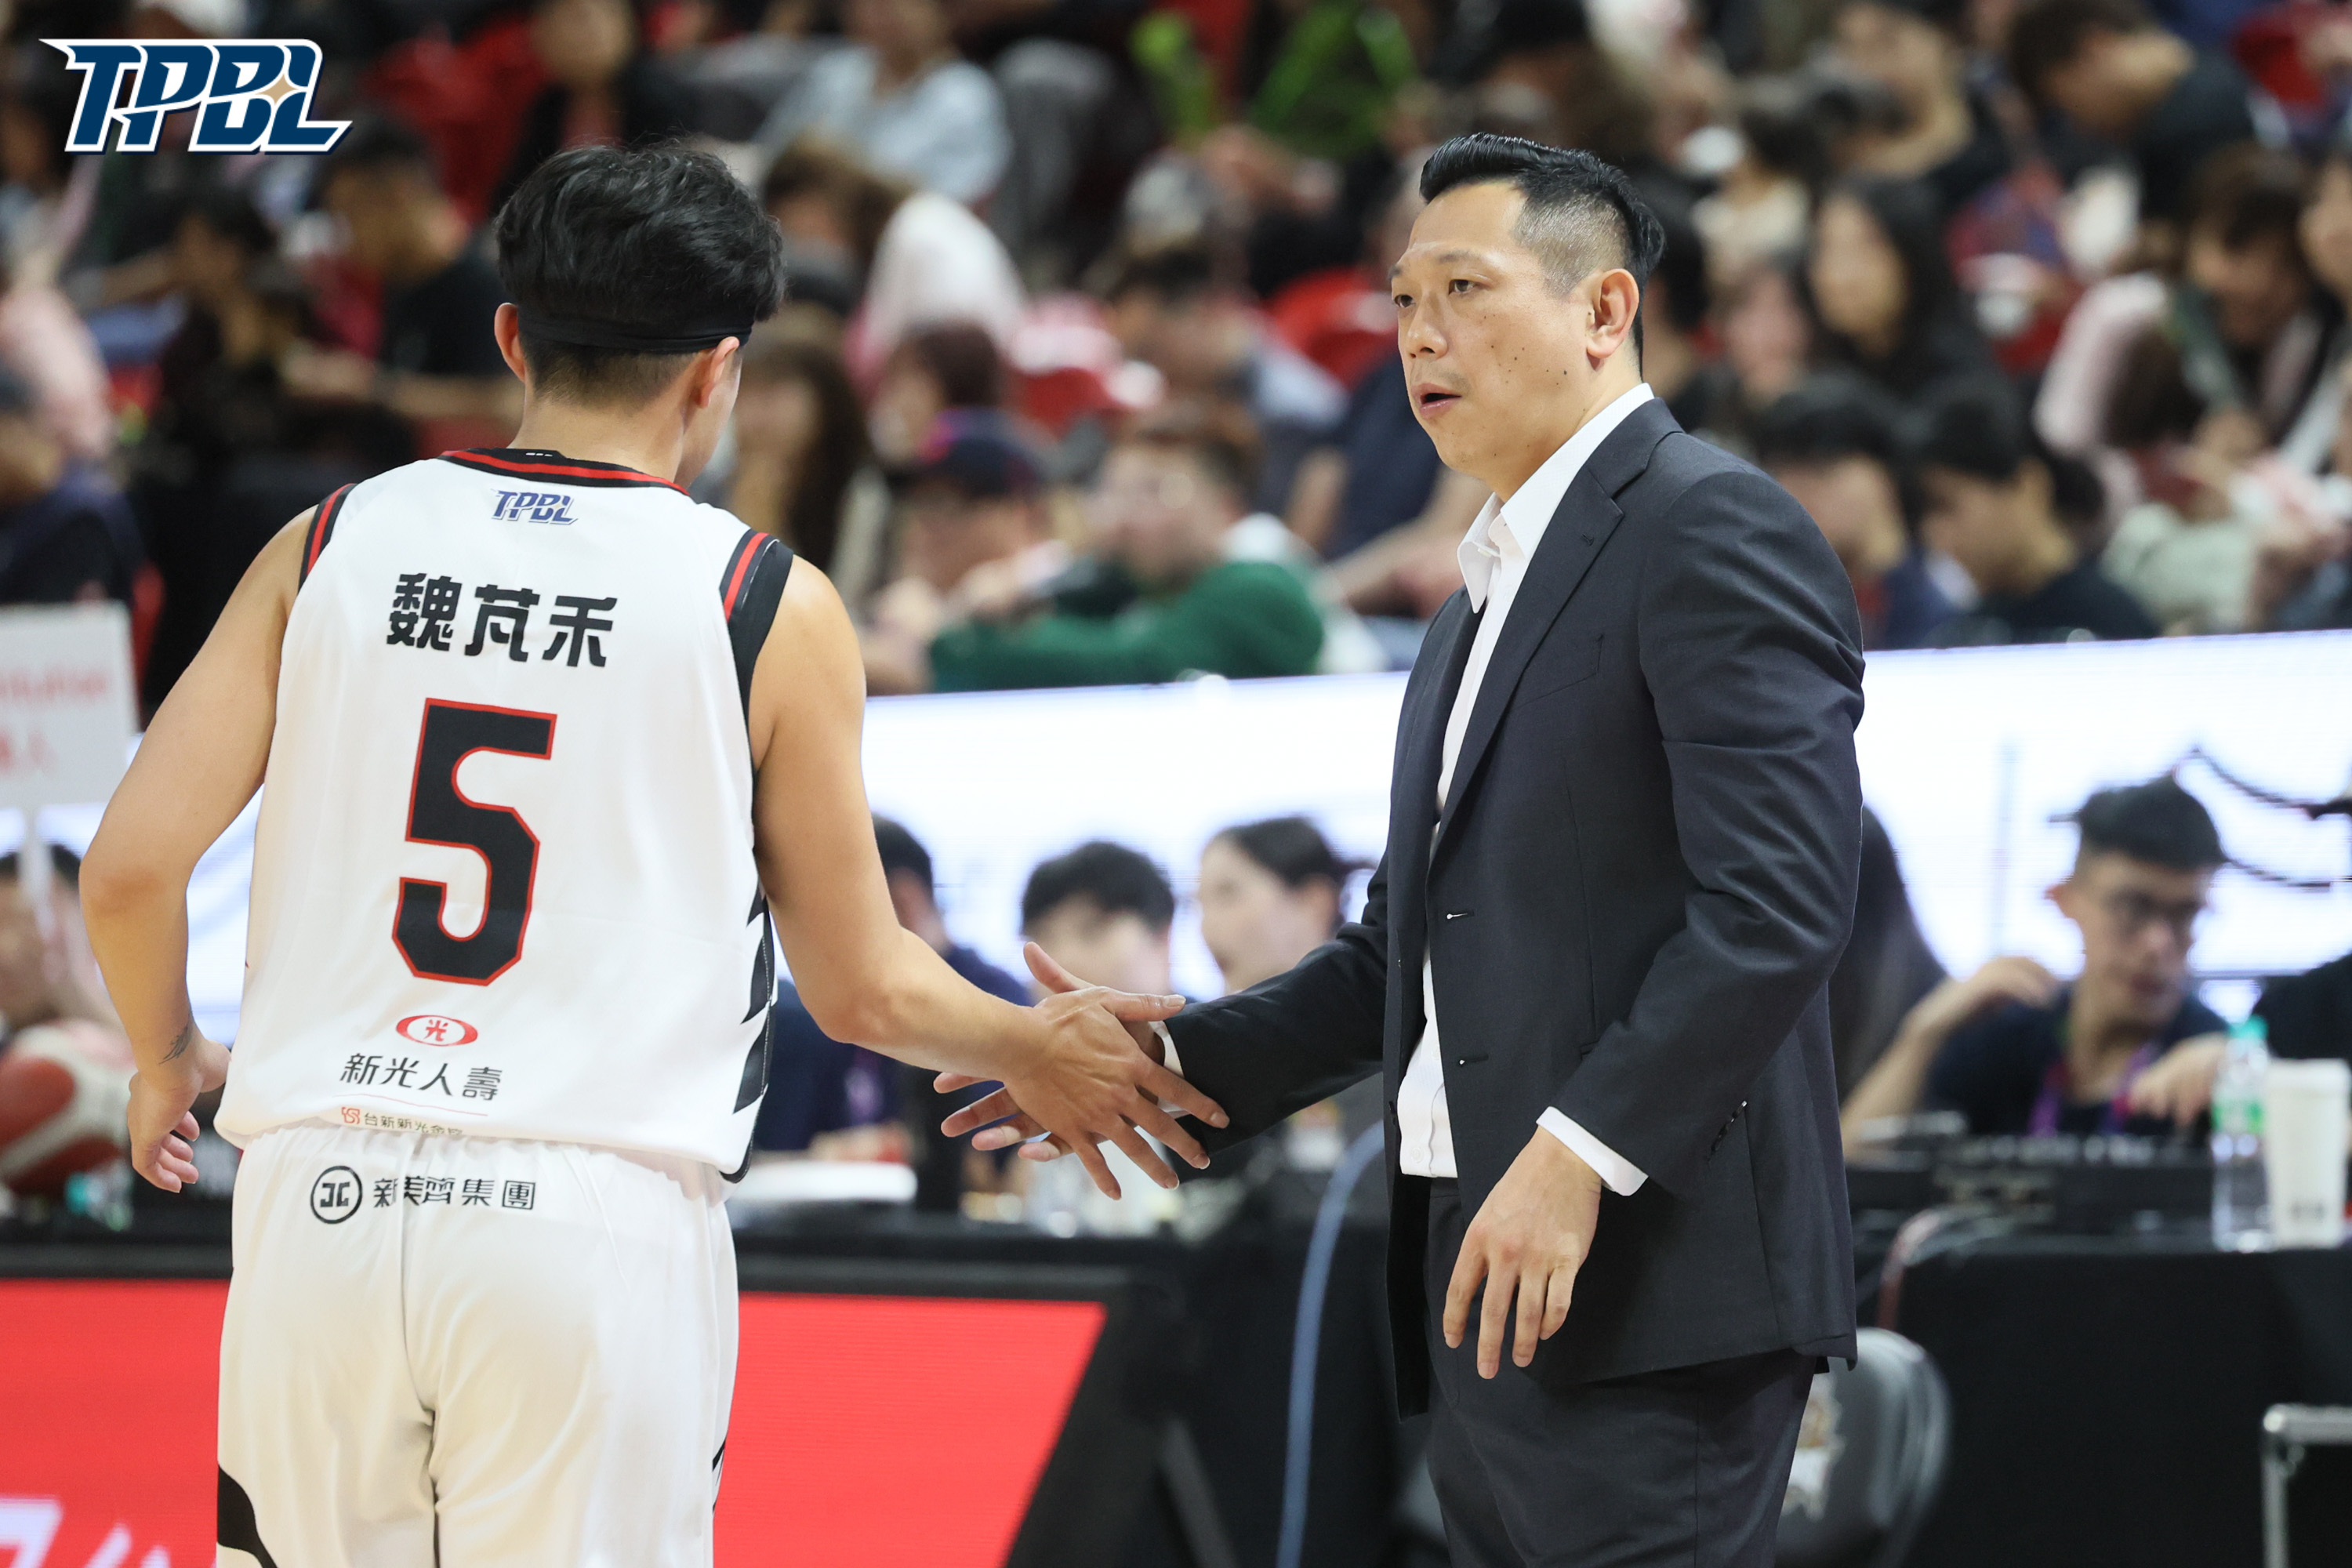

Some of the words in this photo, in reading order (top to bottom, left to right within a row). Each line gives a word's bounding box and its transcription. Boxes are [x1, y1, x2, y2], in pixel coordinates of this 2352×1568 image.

[491, 488, 578, 524] TPBL
[387, 572, 618, 667] 魏芃禾
[392, 698, 557, 986] 5
[423, 1019, 448, 1041] 光
[339, 1053, 503, 1100] 新光人壽
